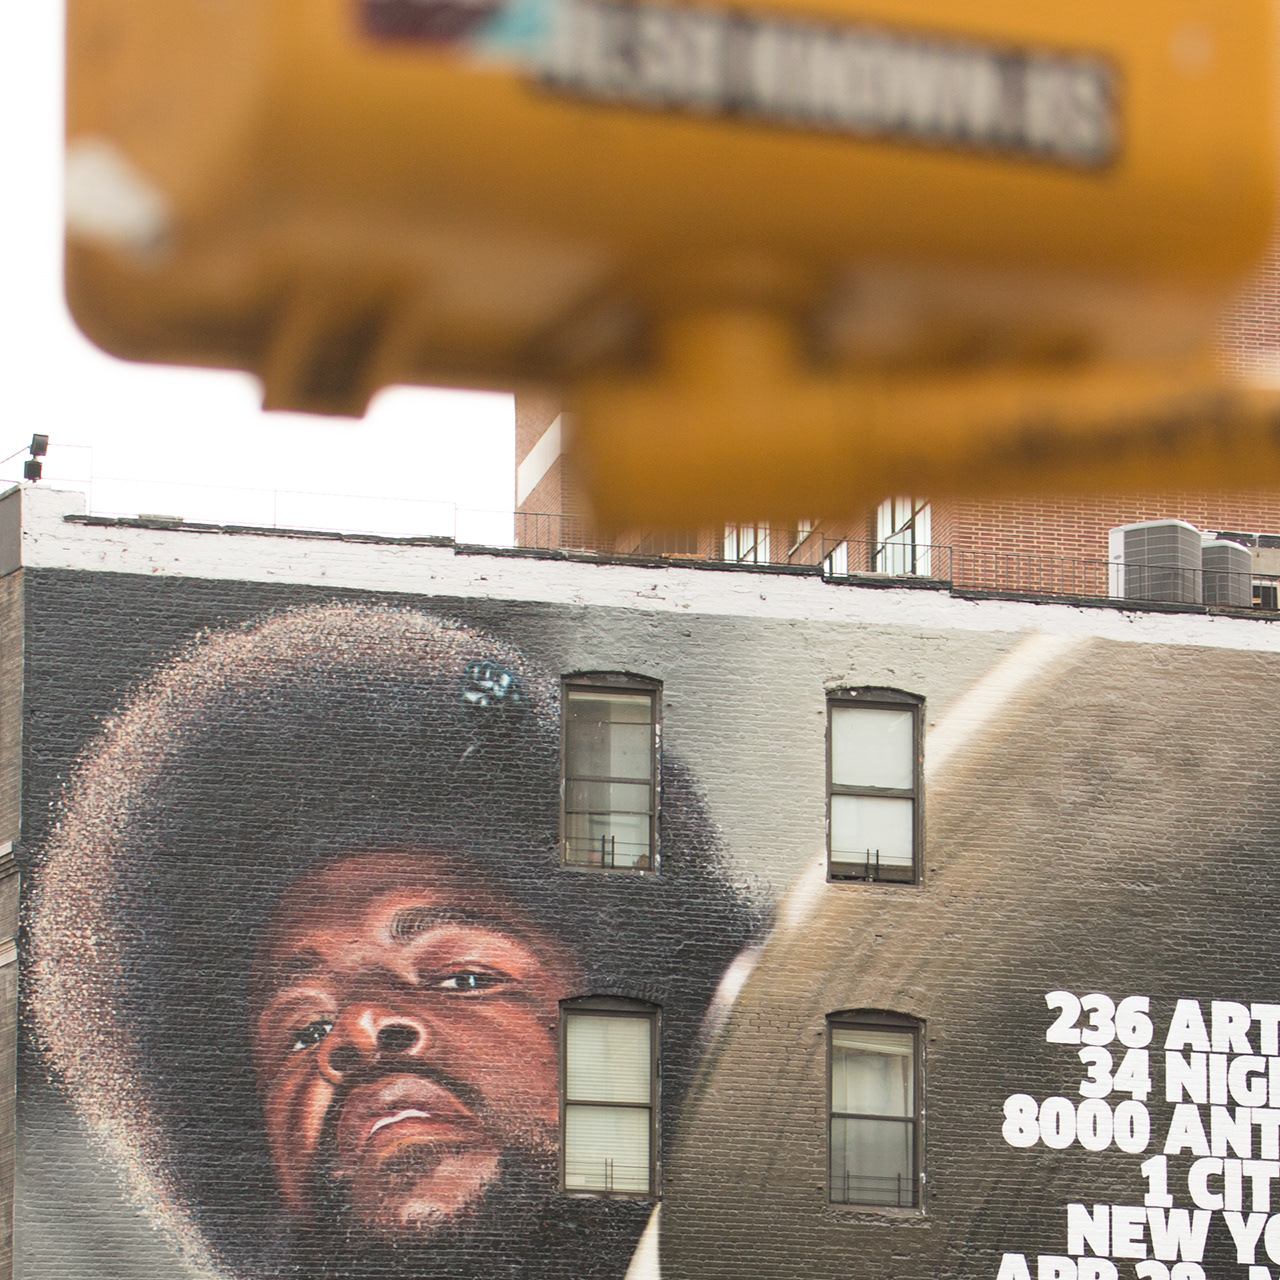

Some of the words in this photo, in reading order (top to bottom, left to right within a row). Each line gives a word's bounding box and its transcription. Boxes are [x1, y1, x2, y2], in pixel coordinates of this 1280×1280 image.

[1045, 990, 1155, 1050] 236
[1078, 1046, 1152, 1100] 34
[1001, 1094, 1152, 1154] 8000
[1141, 1155, 1173, 1208] 1
[1067, 1204, 1212, 1262] NEW
